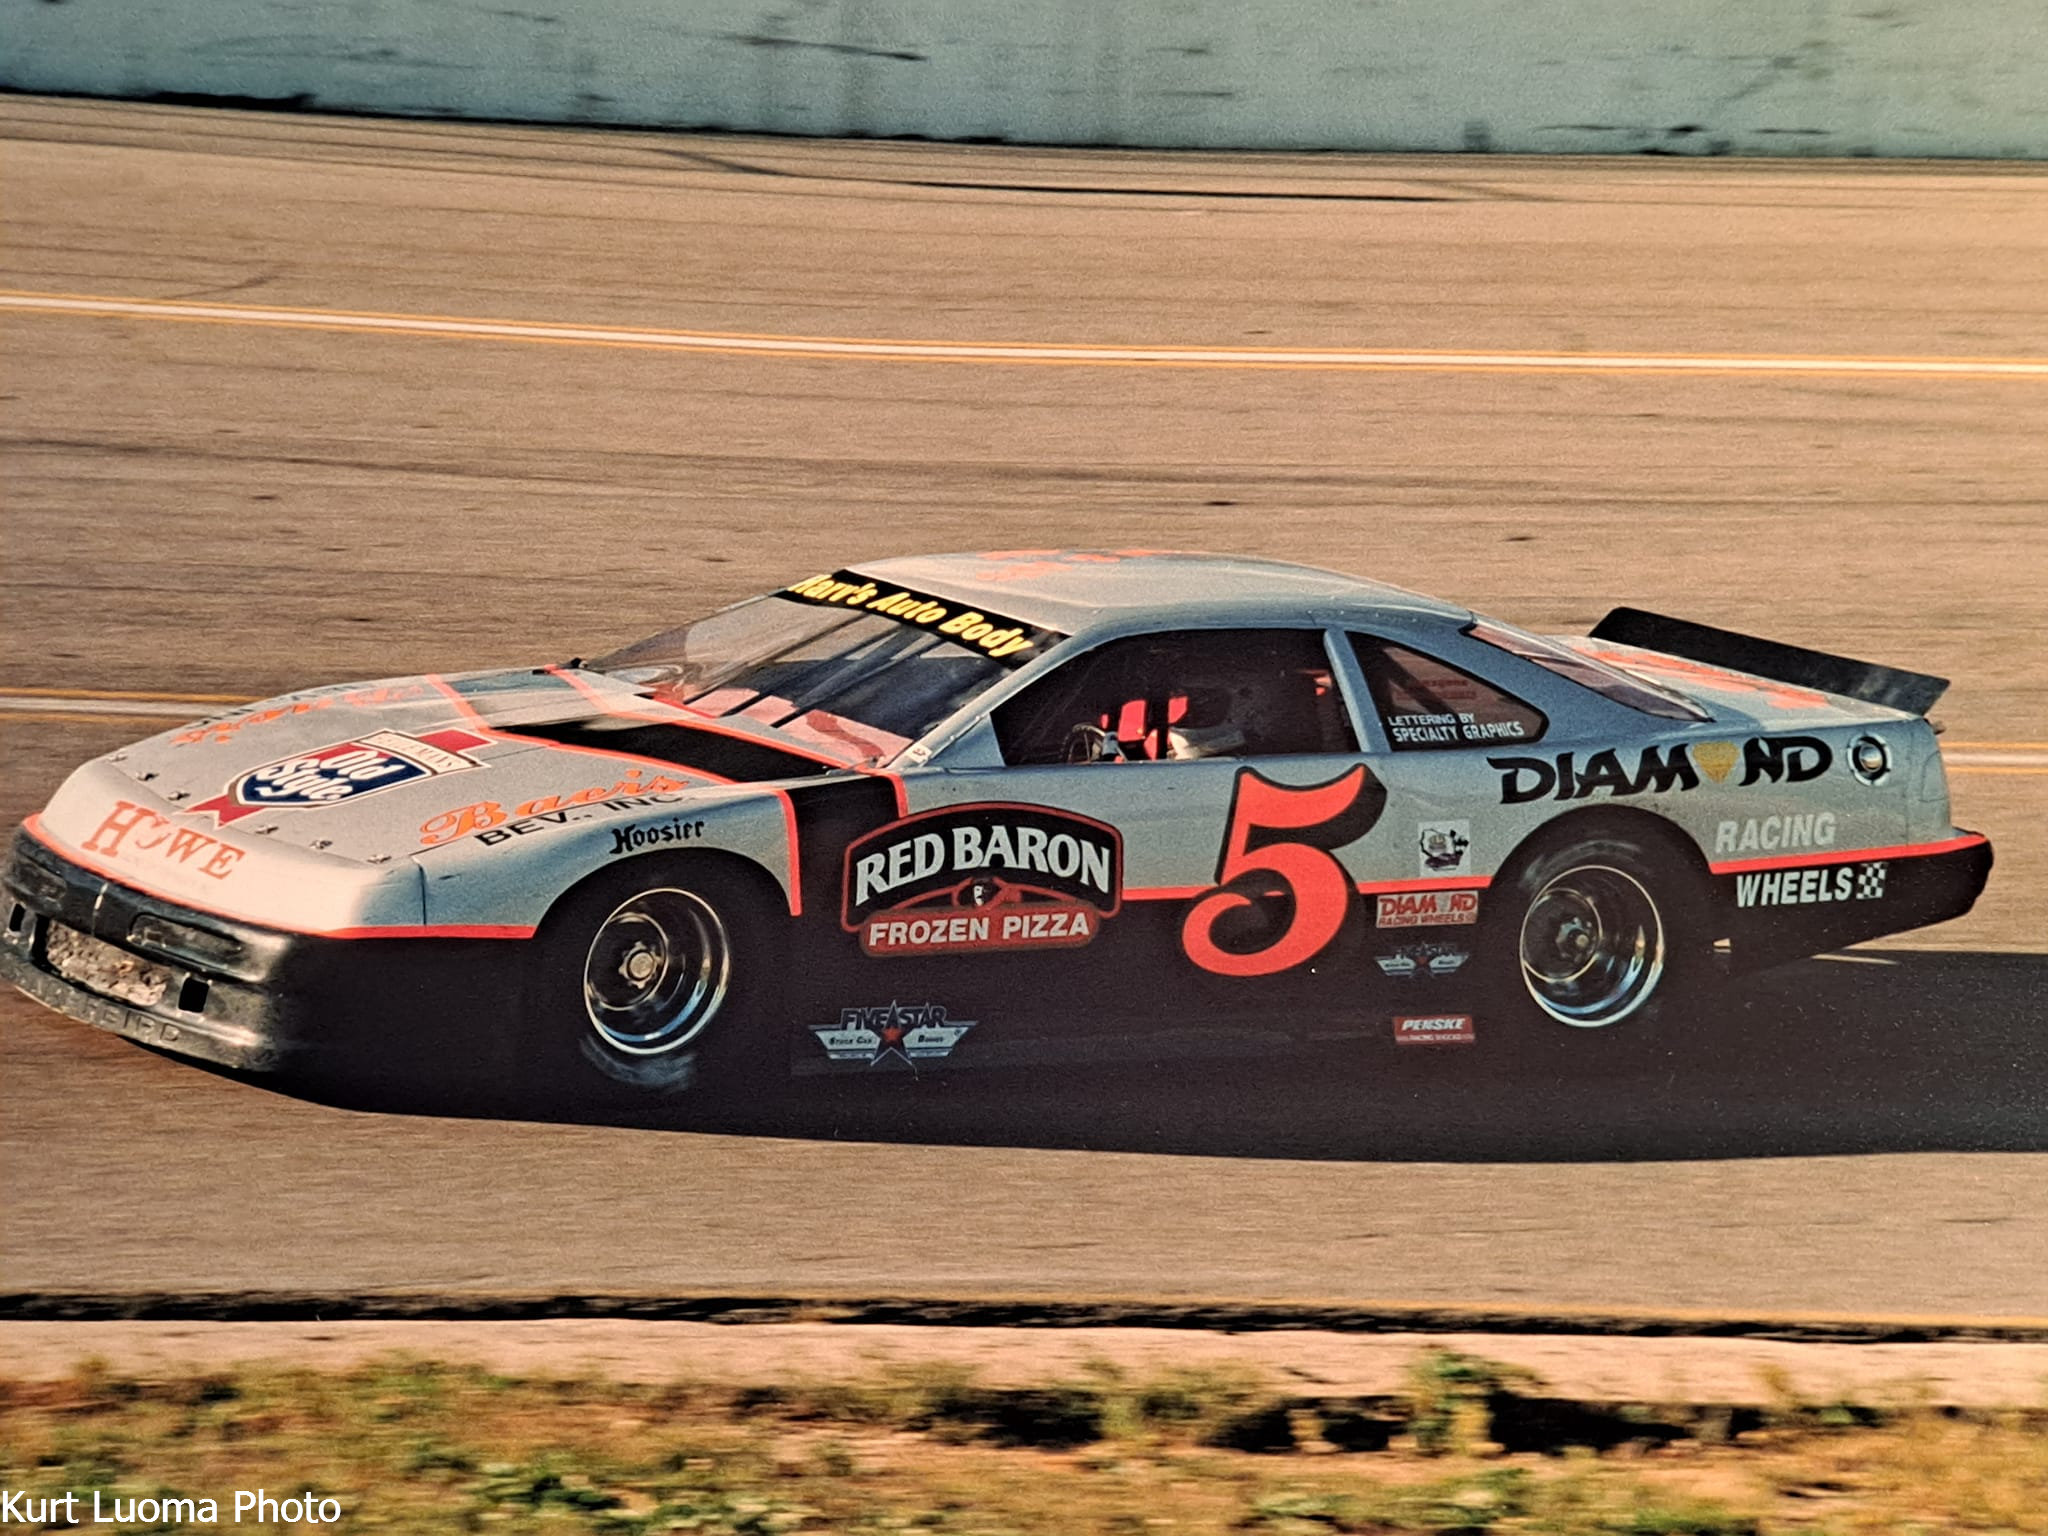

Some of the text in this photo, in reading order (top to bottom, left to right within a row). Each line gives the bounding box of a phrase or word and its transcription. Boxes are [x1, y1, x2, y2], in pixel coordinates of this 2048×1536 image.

[866, 592, 947, 624] Auto
[938, 611, 1034, 657] Body
[1387, 712, 1475, 727] LETTERING BY
[1392, 721, 1525, 743] SPECIALTY GRAPHICS
[254, 757, 354, 801] Style
[319, 749, 407, 781] Old
[608, 816, 705, 855] Hoosier
[1714, 812, 1838, 854] RACING
[855, 825, 1111, 907] RED BARON
[1182, 762, 1388, 977] 5
[1735, 867, 1855, 909] WHEELS
[868, 912, 1090, 947] FROZEN PIZZA
